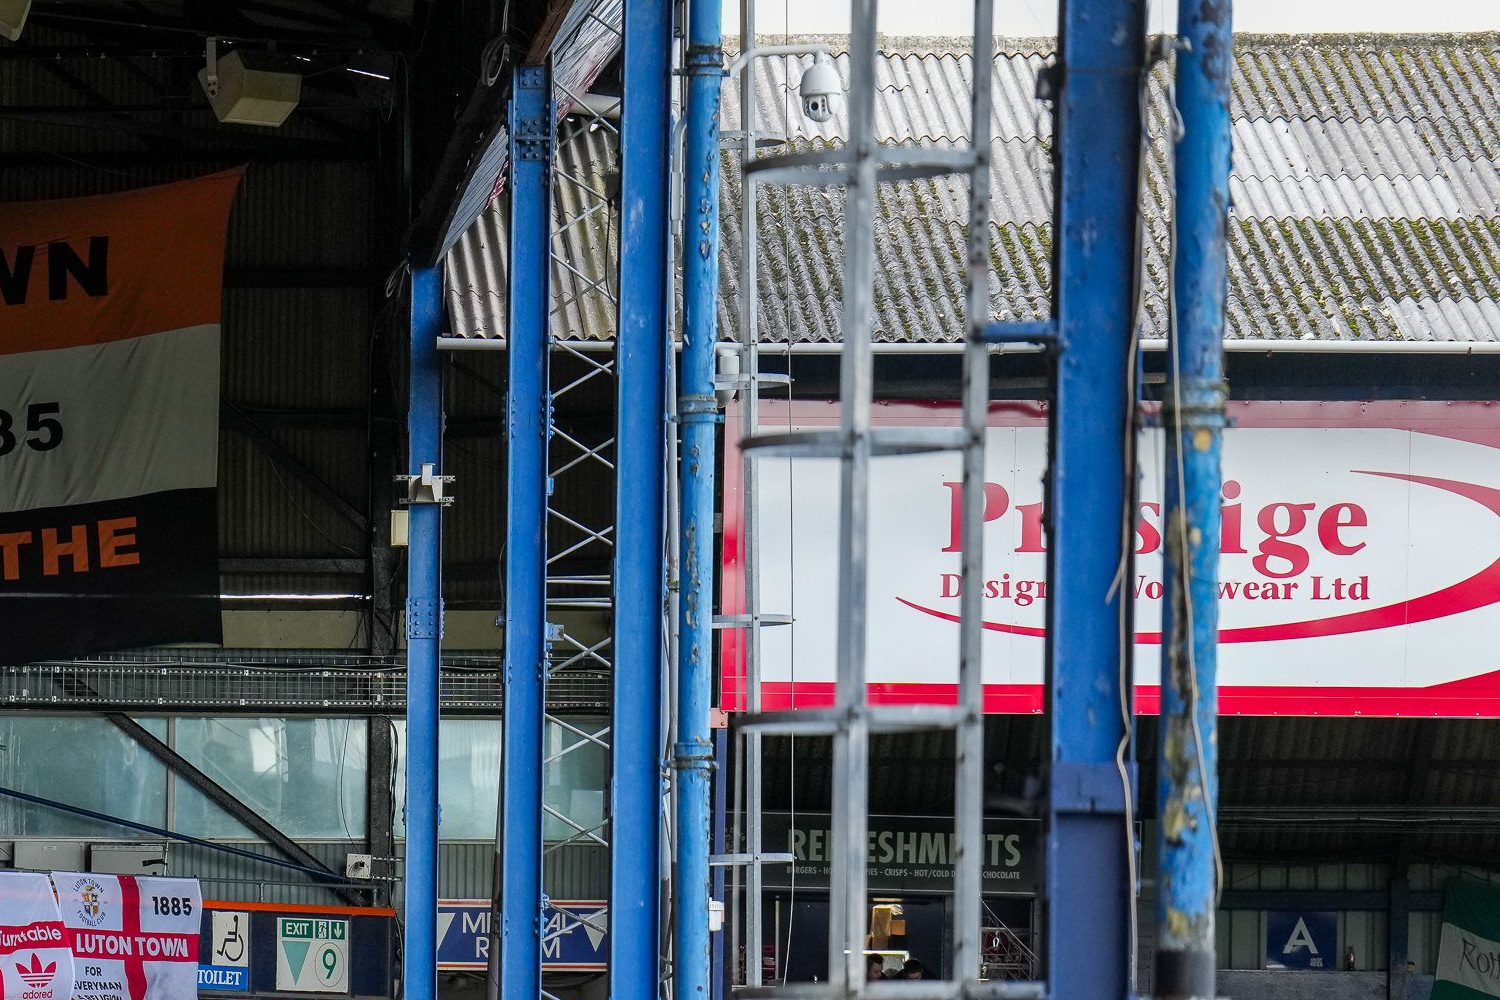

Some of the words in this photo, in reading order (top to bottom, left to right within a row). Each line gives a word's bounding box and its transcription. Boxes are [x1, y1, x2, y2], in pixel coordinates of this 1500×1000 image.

[941, 479, 1368, 579] Prsige
[1310, 575, 1371, 601] Ltd
[884, 868, 908, 877] CRISPS
[914, 869, 950, 879] HOT/COLD
[982, 871, 1021, 880] CHOCOLATE
[152, 896, 193, 917] 1885
[285, 922, 310, 936] EXIT
[1282, 916, 1319, 954] A
[76, 933, 133, 956] LUTON
[135, 936, 189, 958] TOWN
[85, 966, 102, 976] FOR
[322, 948, 337, 980] 9
[74, 980, 122, 991] EVERYMAN
[197, 969, 242, 986] TOILET
[22, 989, 54, 1000] adored
